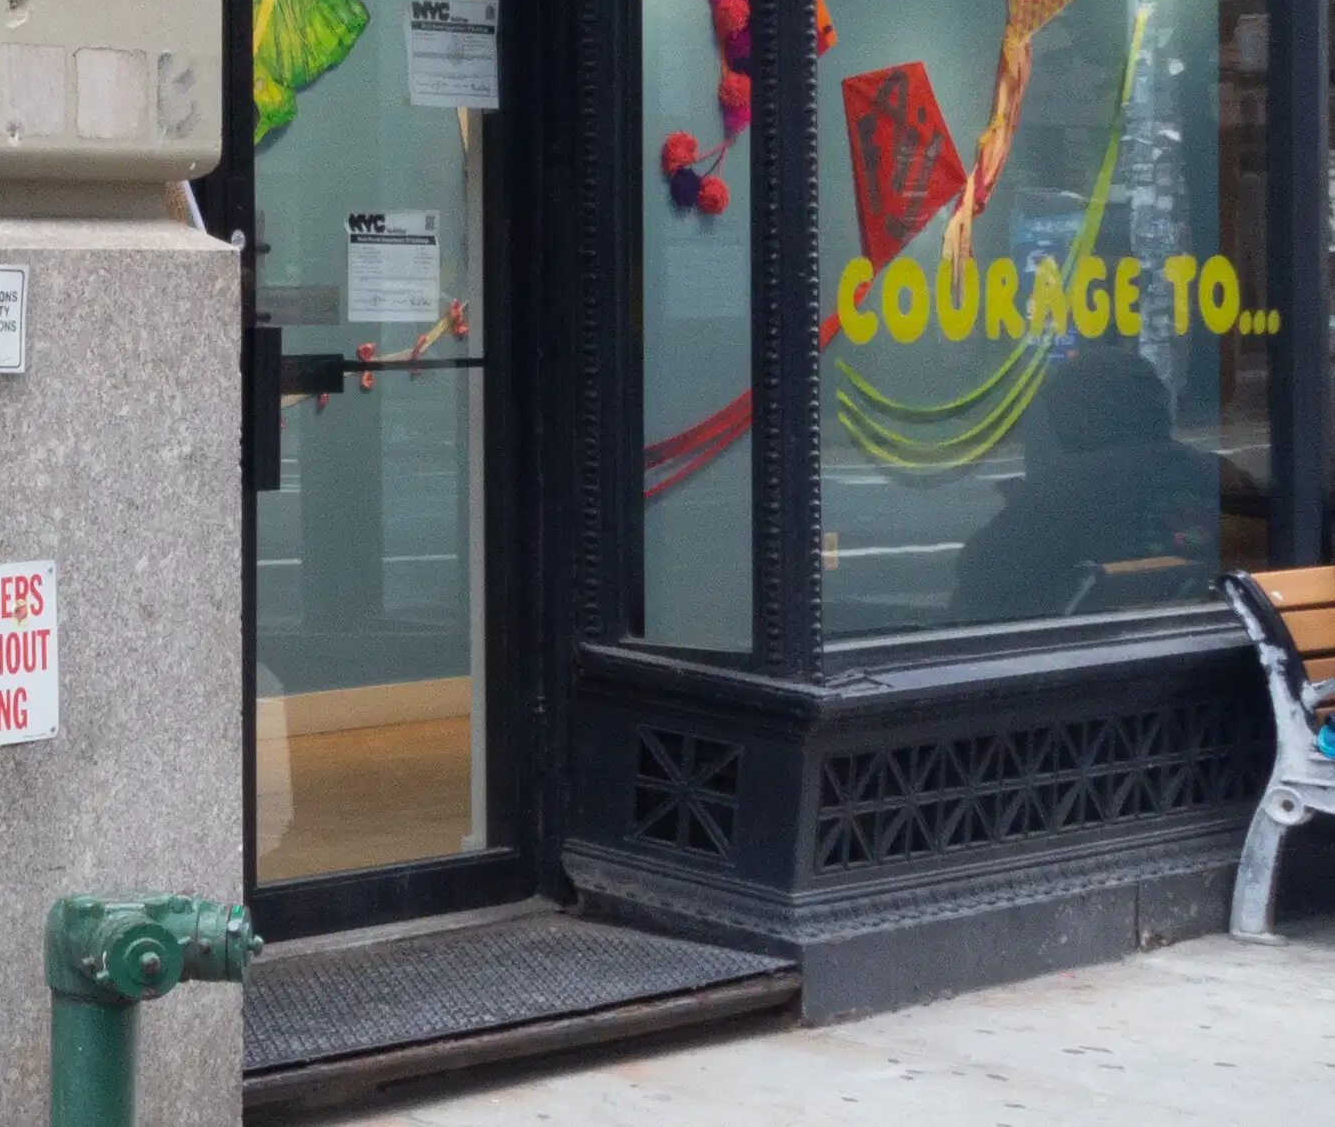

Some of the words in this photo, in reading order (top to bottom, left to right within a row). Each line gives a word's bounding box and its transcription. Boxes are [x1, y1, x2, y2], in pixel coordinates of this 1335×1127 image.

[411, 0, 450, 21] NYC
[349, 213, 386, 233] NYC
[837, 256, 1141, 344] COURAGE
[1163, 253, 1281, 336] TO...
